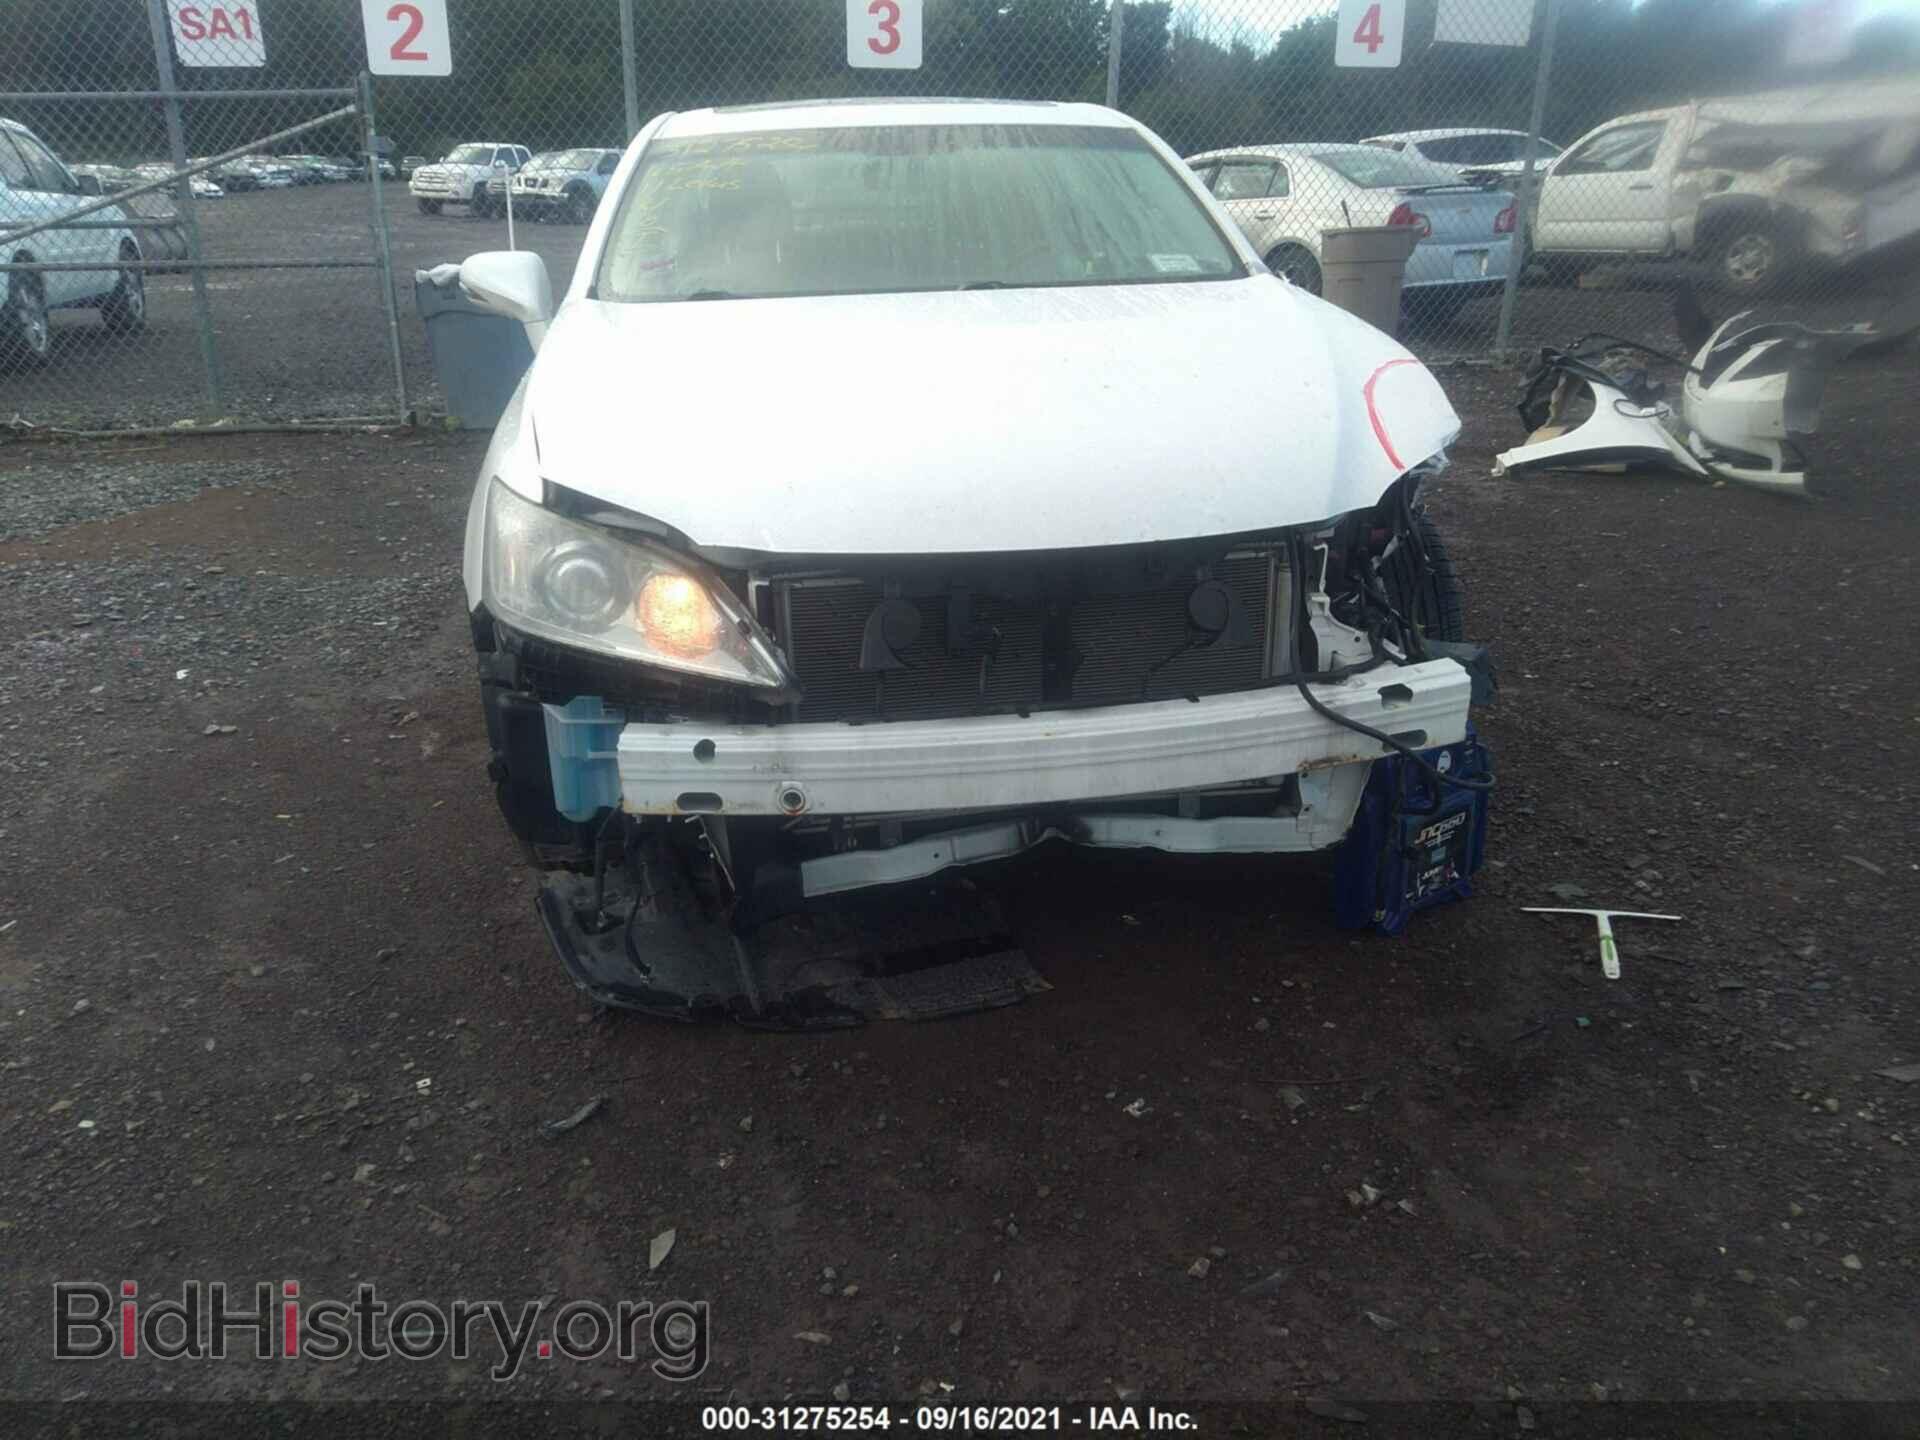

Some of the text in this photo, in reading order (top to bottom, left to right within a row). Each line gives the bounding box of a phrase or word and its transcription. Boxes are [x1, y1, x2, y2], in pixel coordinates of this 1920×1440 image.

[178, 7, 255, 41] SA1
[386, 3, 428, 61] 2
[867, 0, 901, 55] 3
[1353, 3, 1384, 54] 4
